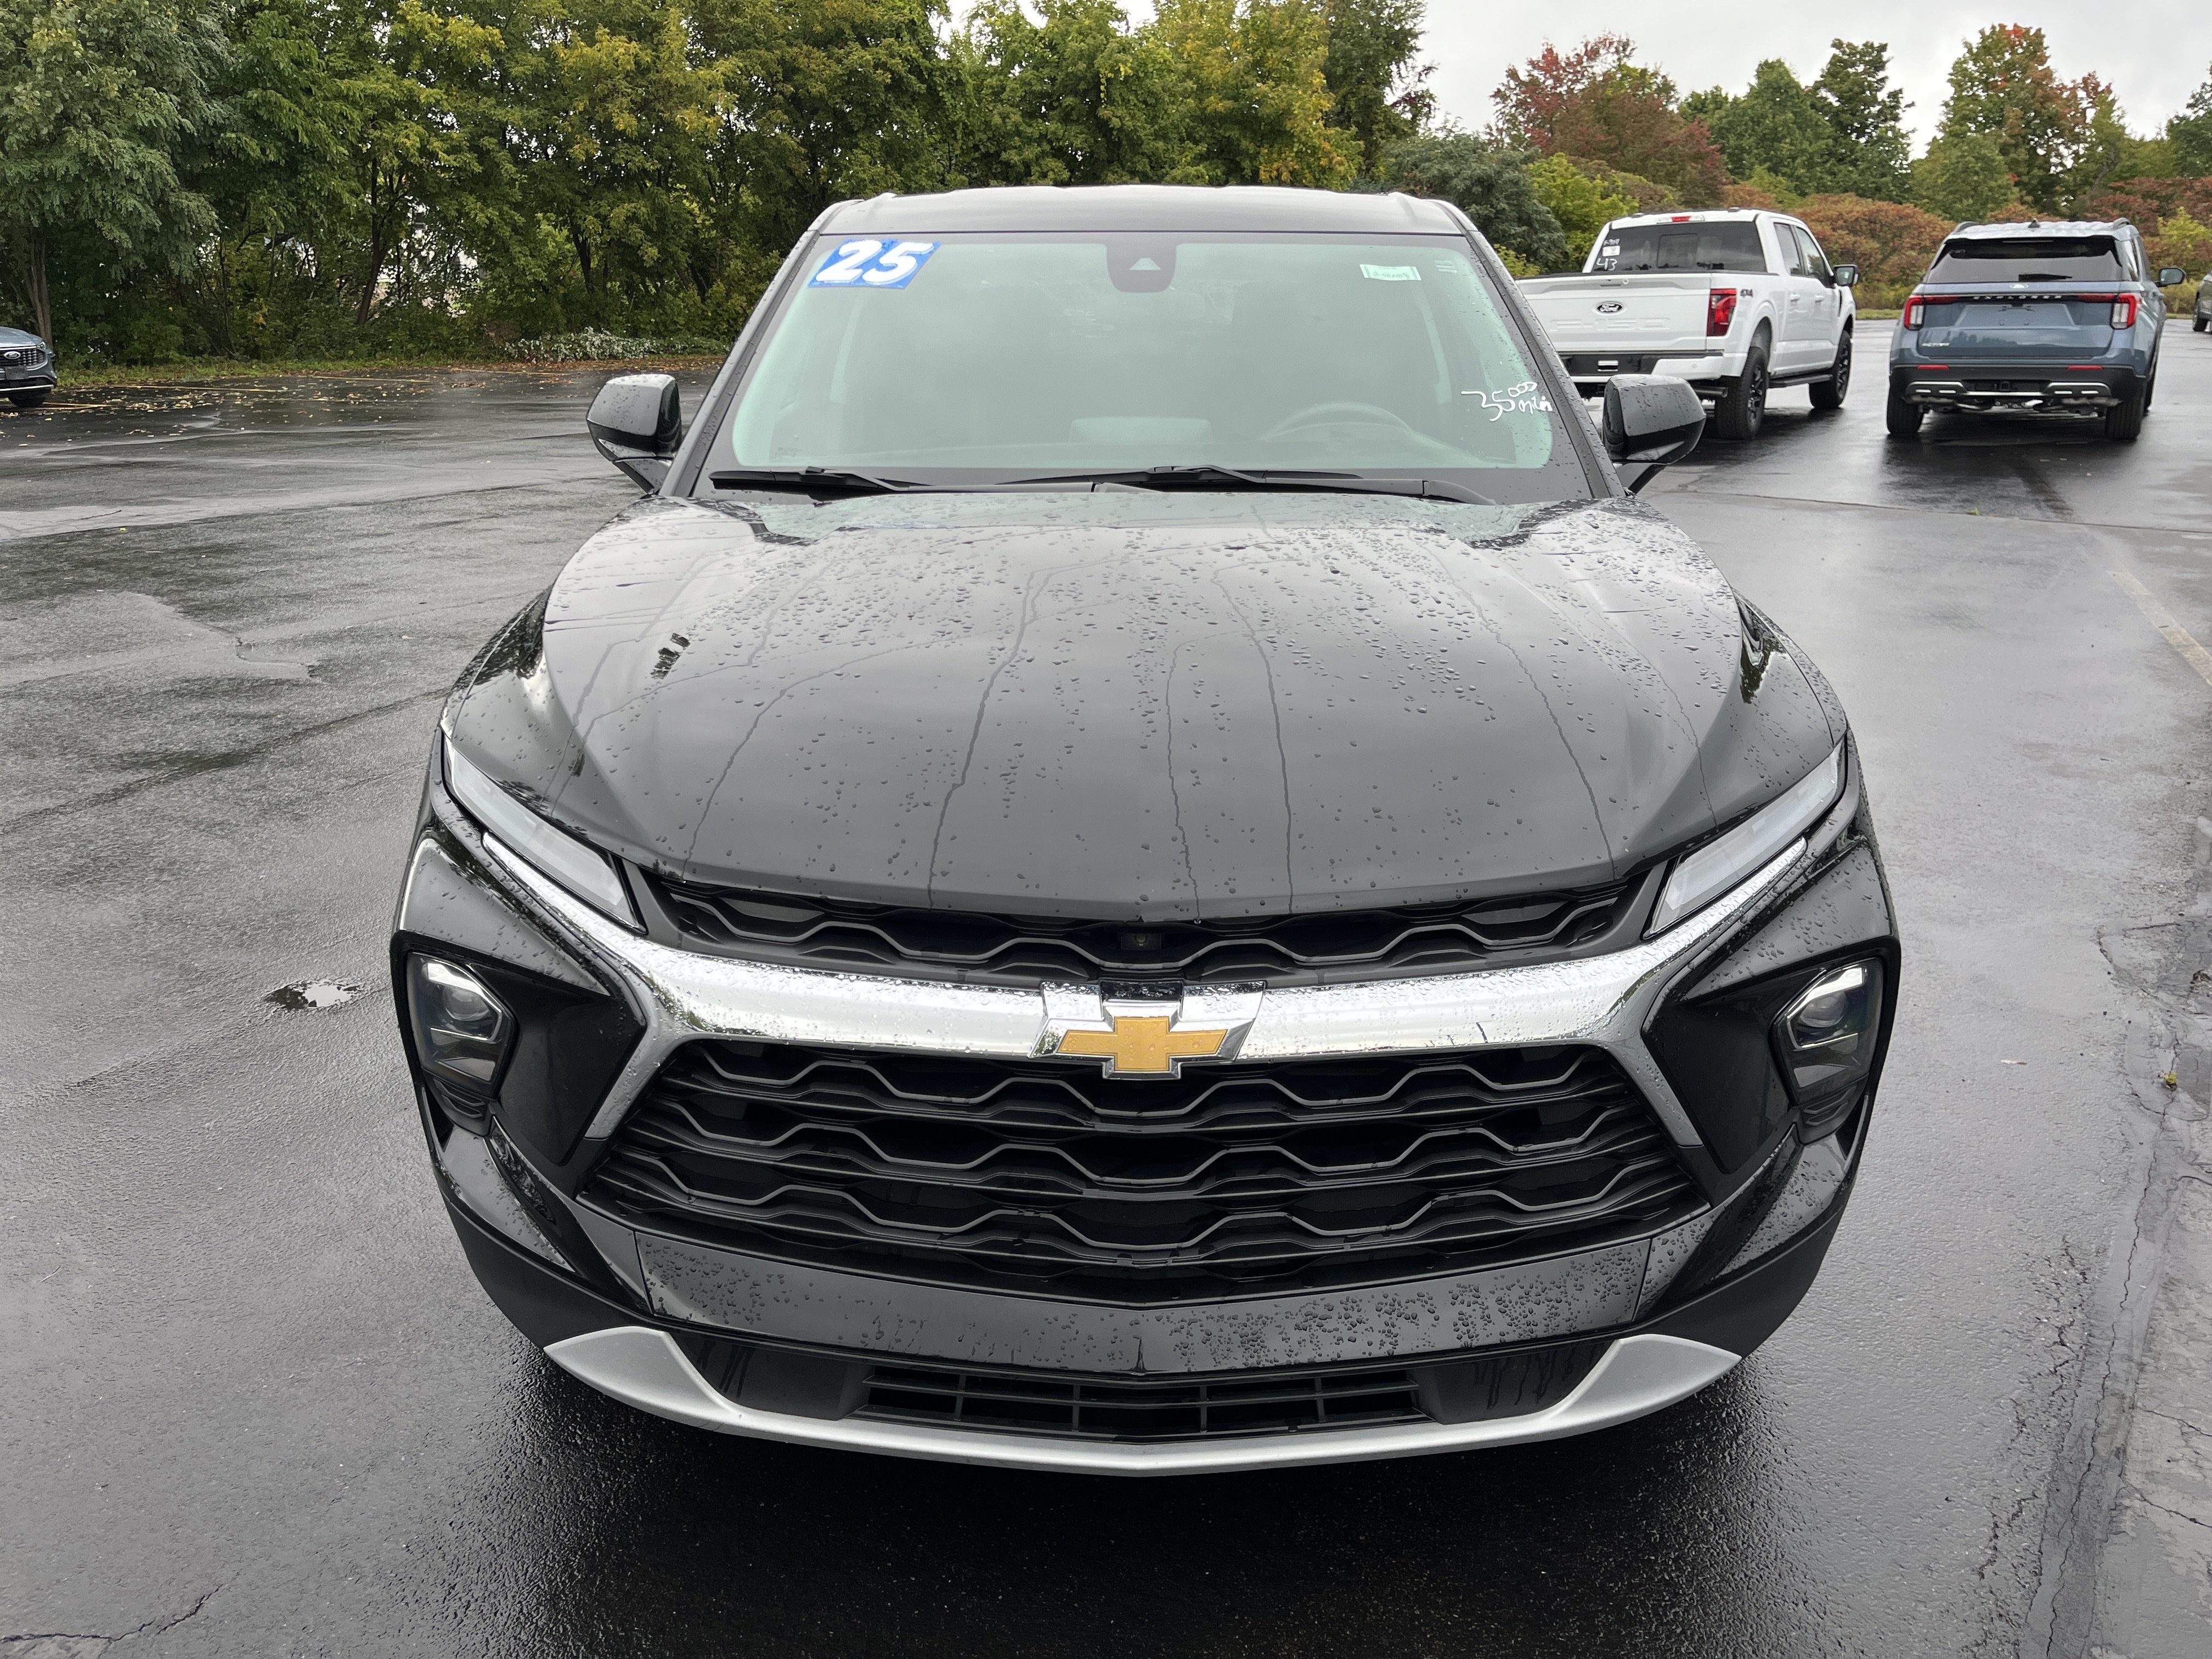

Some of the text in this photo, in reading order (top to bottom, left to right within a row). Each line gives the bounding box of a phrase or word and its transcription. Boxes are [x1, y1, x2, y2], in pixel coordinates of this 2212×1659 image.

[816, 240, 934, 285] 25
[1596, 258, 1618, 270] 43
[1549, 317, 1671, 331] F-150
